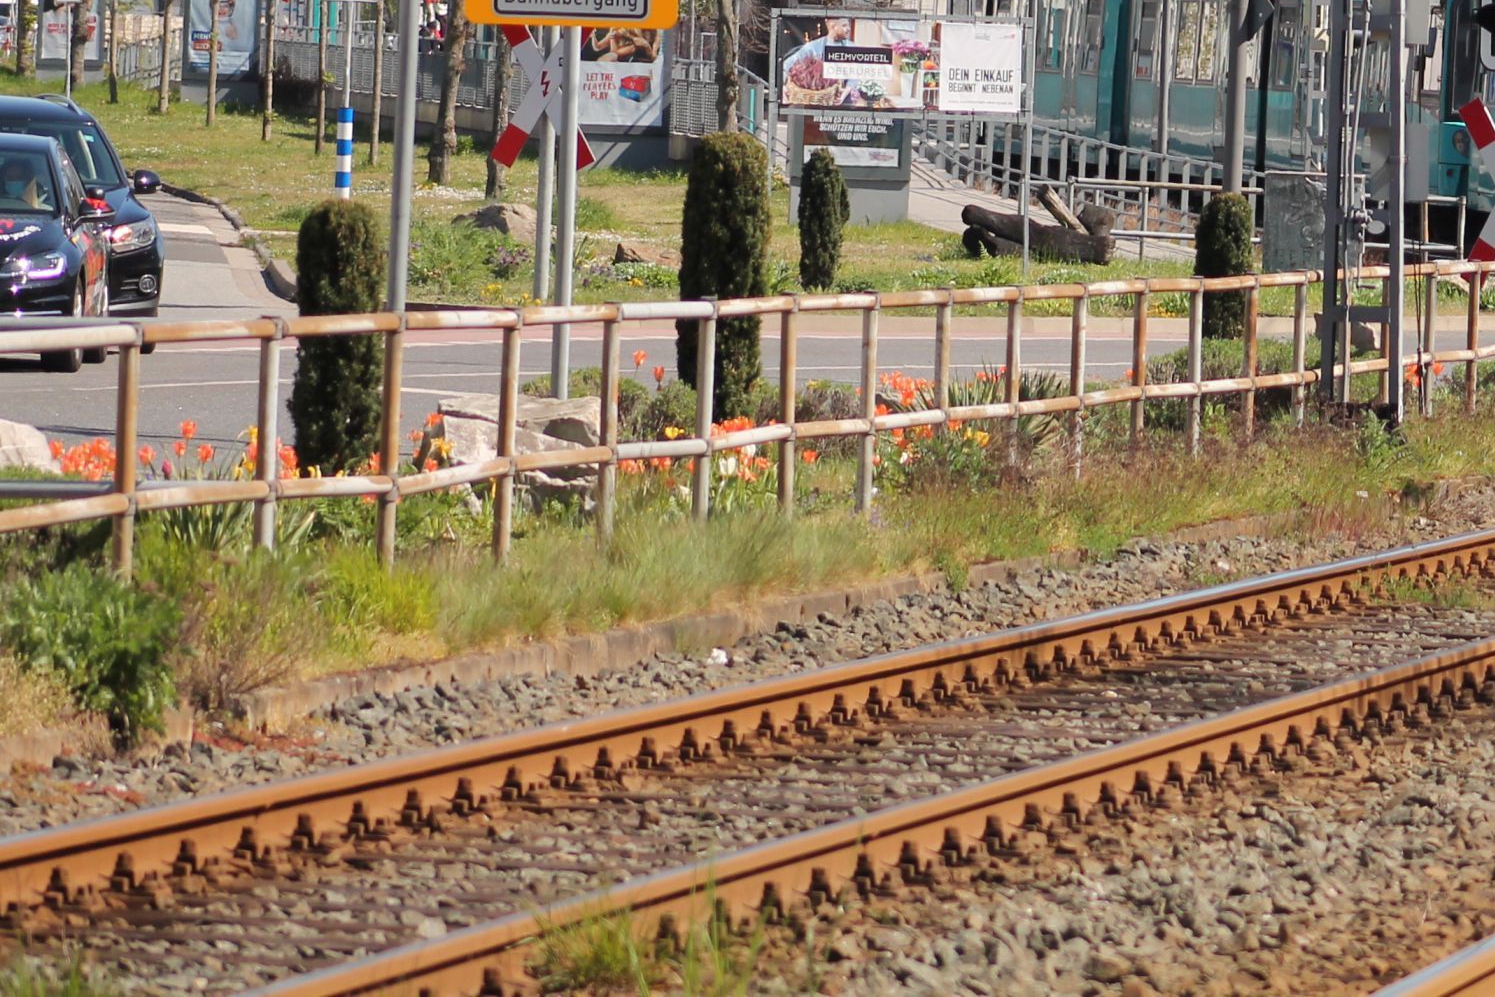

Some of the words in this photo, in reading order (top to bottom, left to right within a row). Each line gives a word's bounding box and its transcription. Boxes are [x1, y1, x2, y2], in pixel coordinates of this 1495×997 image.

[827, 66, 889, 77] OBERURSEL
[949, 68, 969, 81] DEIN
[975, 69, 1014, 83] EINKAUF
[586, 73, 600, 81] LET
[601, 73, 614, 81] THE
[583, 82, 616, 91] PLAYERS
[948, 82, 976, 92] BEGINNT
[982, 84, 1014, 94] NEBENAN
[591, 91, 609, 100] PLAY
[854, 124, 867, 132] WIR
[868, 125, 888, 134] EUCH.
[837, 132, 852, 140] UND
[853, 133, 869, 141] UNS.
